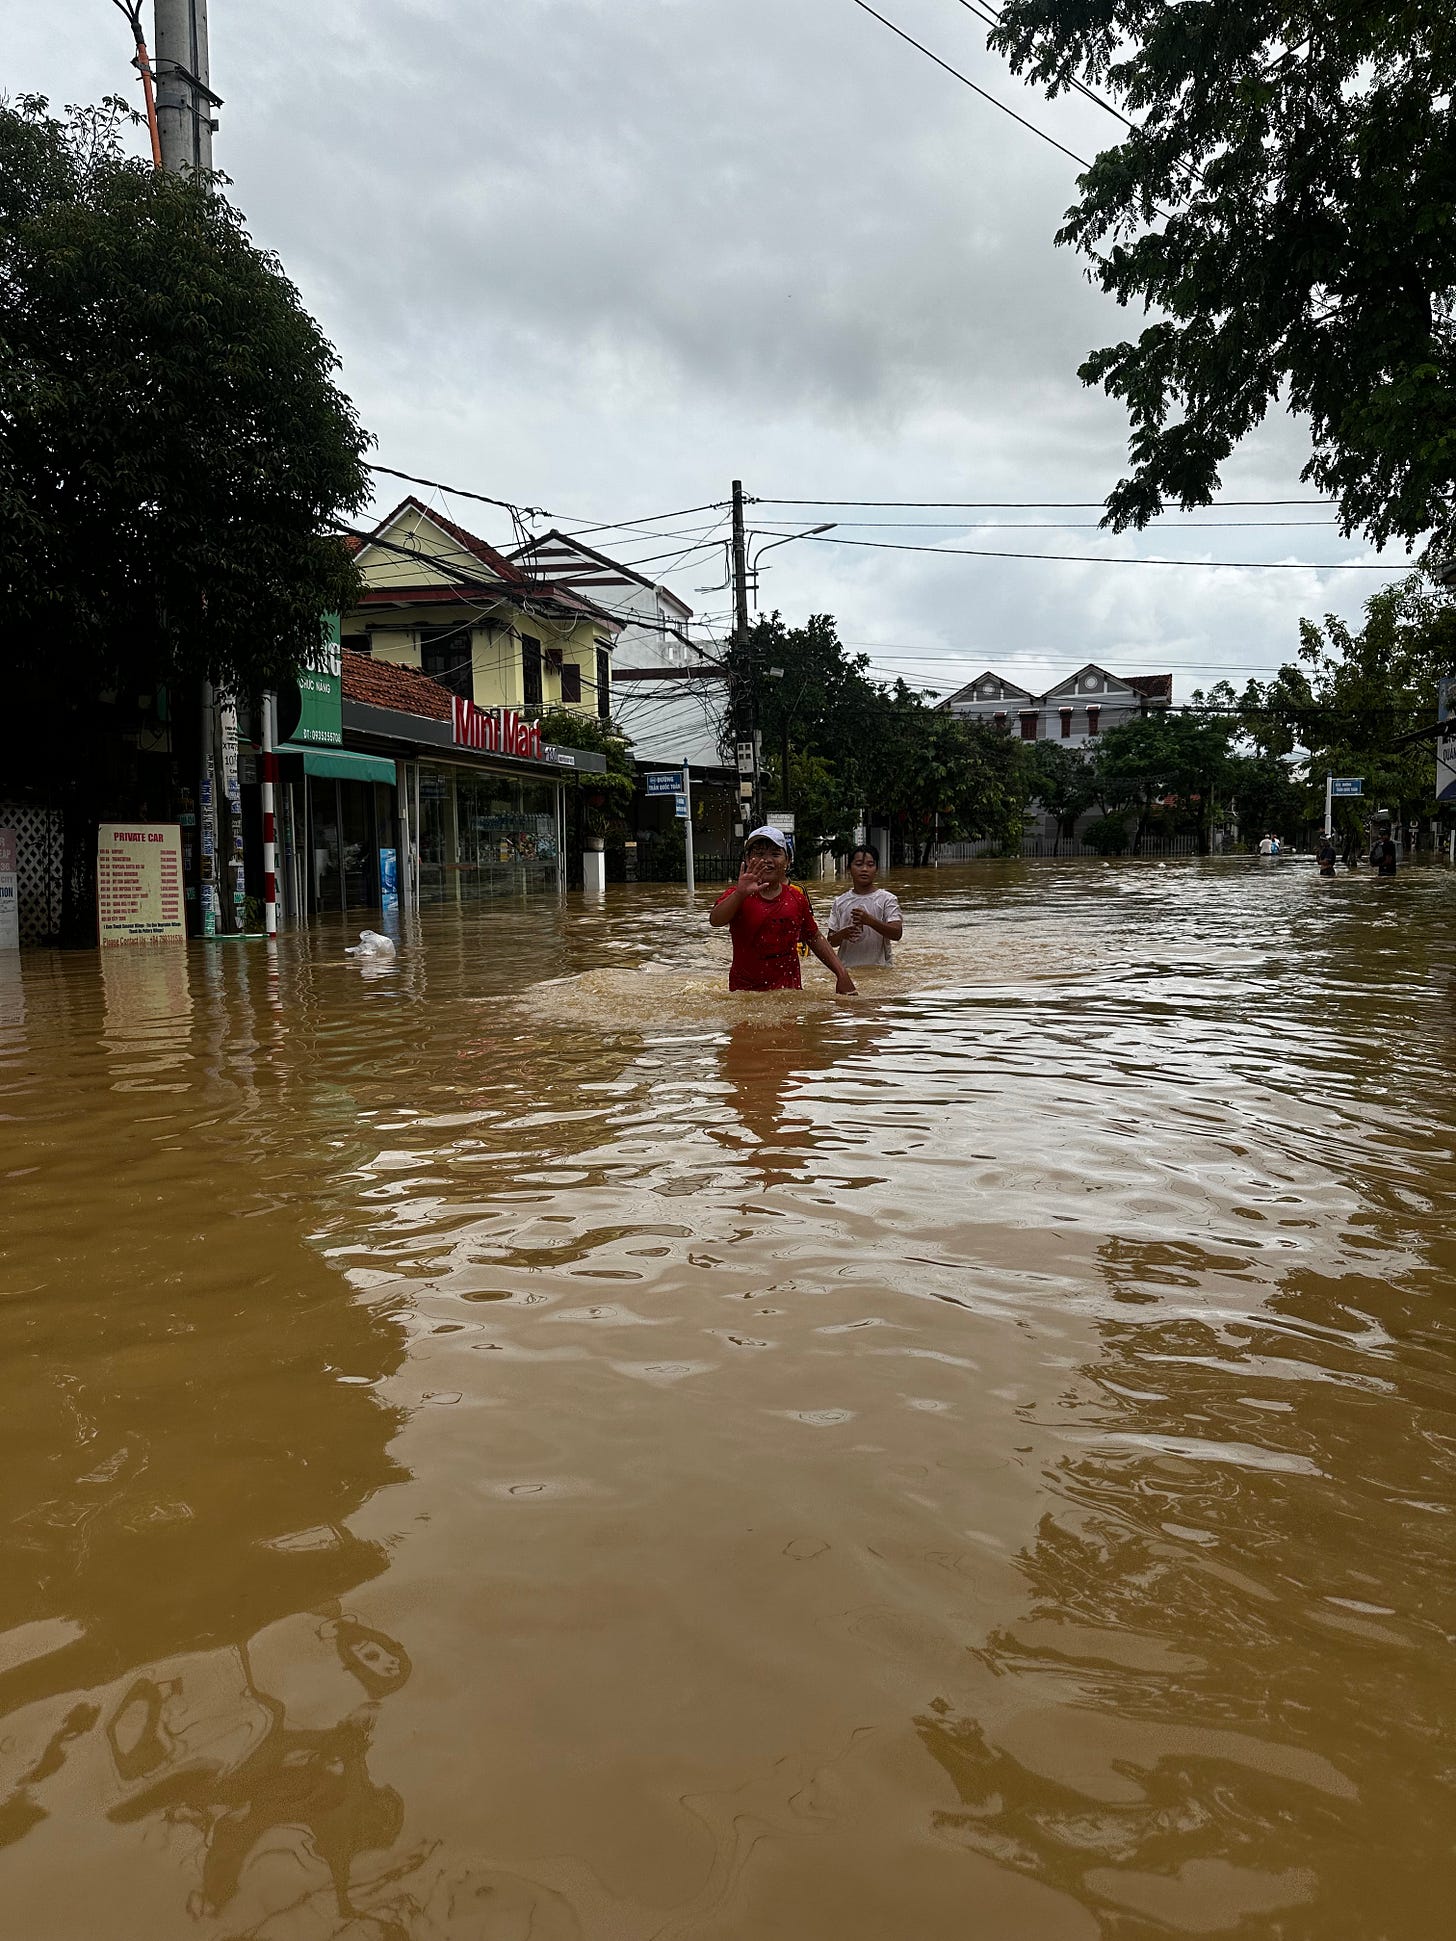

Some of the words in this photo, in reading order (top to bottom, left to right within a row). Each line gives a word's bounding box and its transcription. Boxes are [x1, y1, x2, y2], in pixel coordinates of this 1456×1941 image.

[451, 695, 498, 753] Mini
[500, 708, 542, 760] Mart
[113, 832, 146, 842] PRIVATE
[148, 833, 164, 843] CAR
